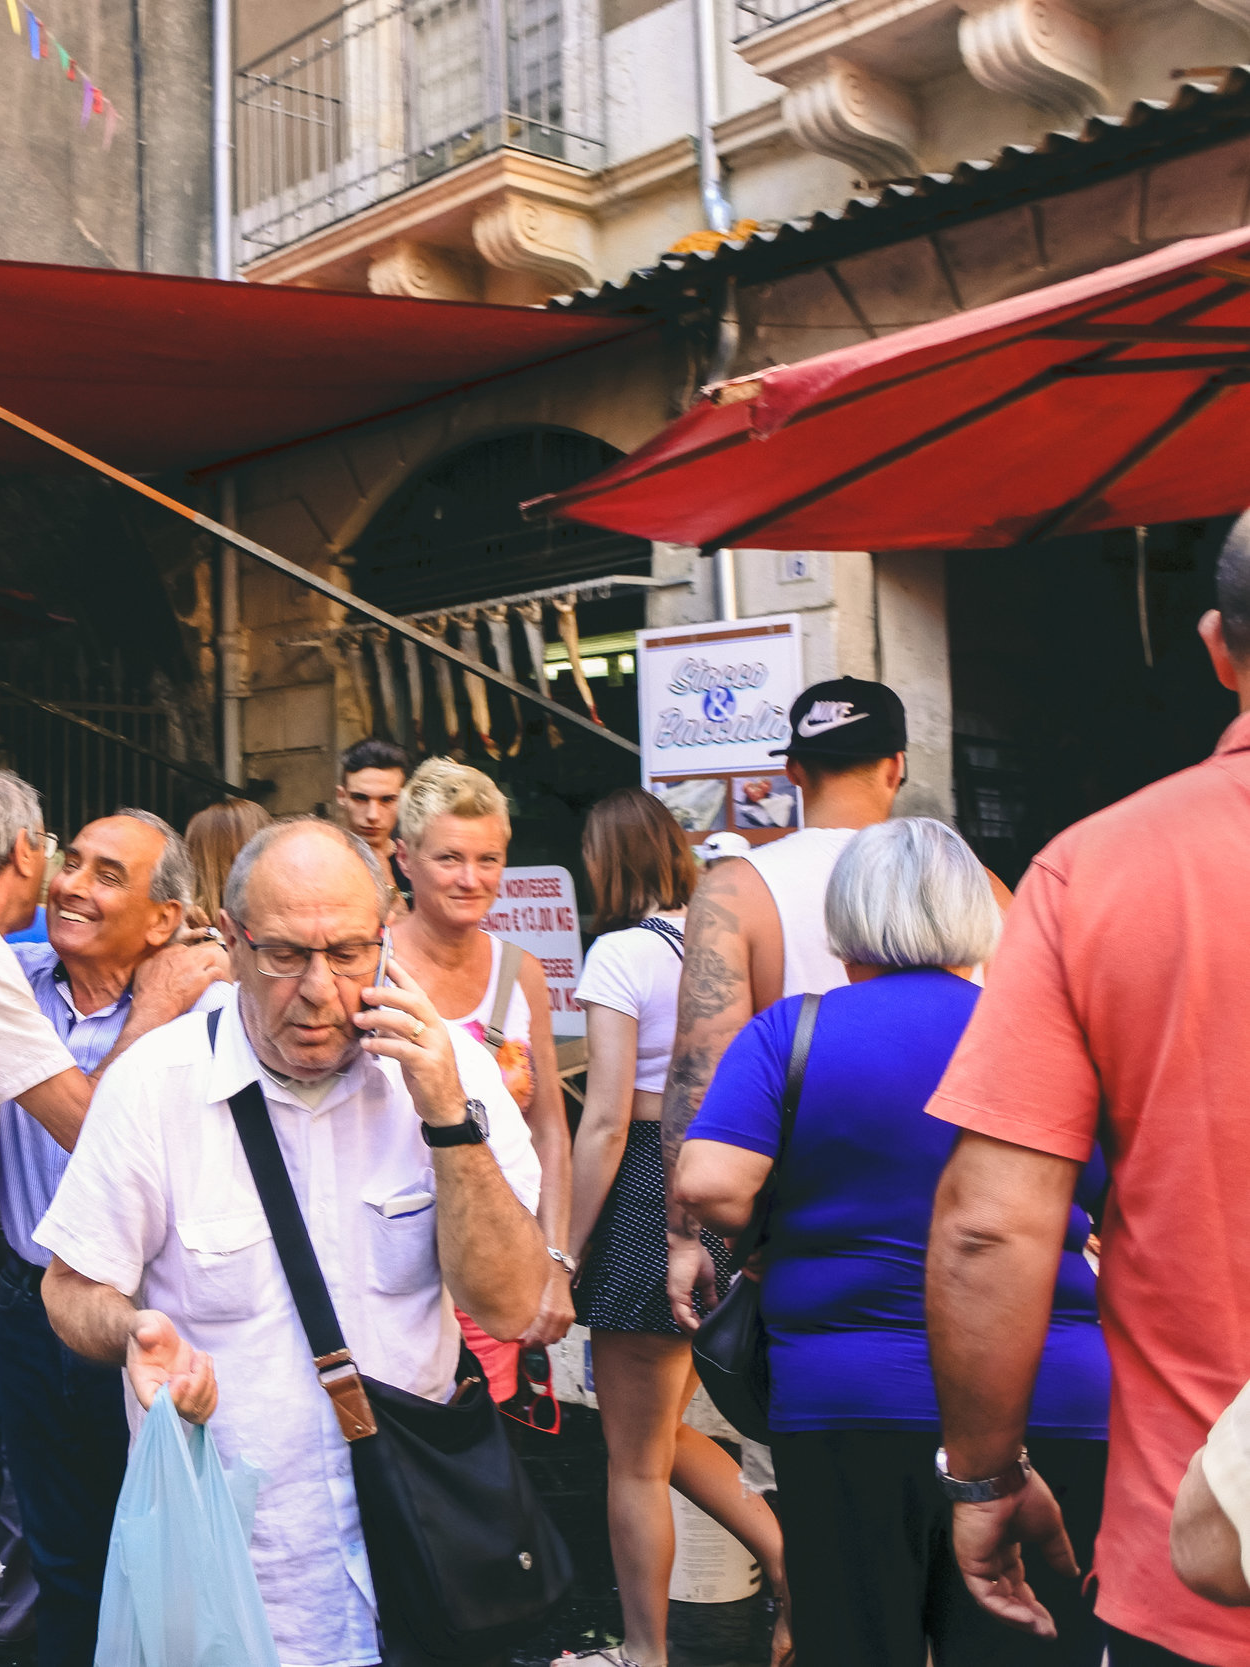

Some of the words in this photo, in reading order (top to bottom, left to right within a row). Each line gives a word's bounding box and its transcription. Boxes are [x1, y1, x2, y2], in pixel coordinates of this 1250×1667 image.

[668, 657, 769, 695] Stocco
[705, 686, 735, 722] &
[809, 700, 855, 722] NIKE
[556, 907, 574, 931] KG
